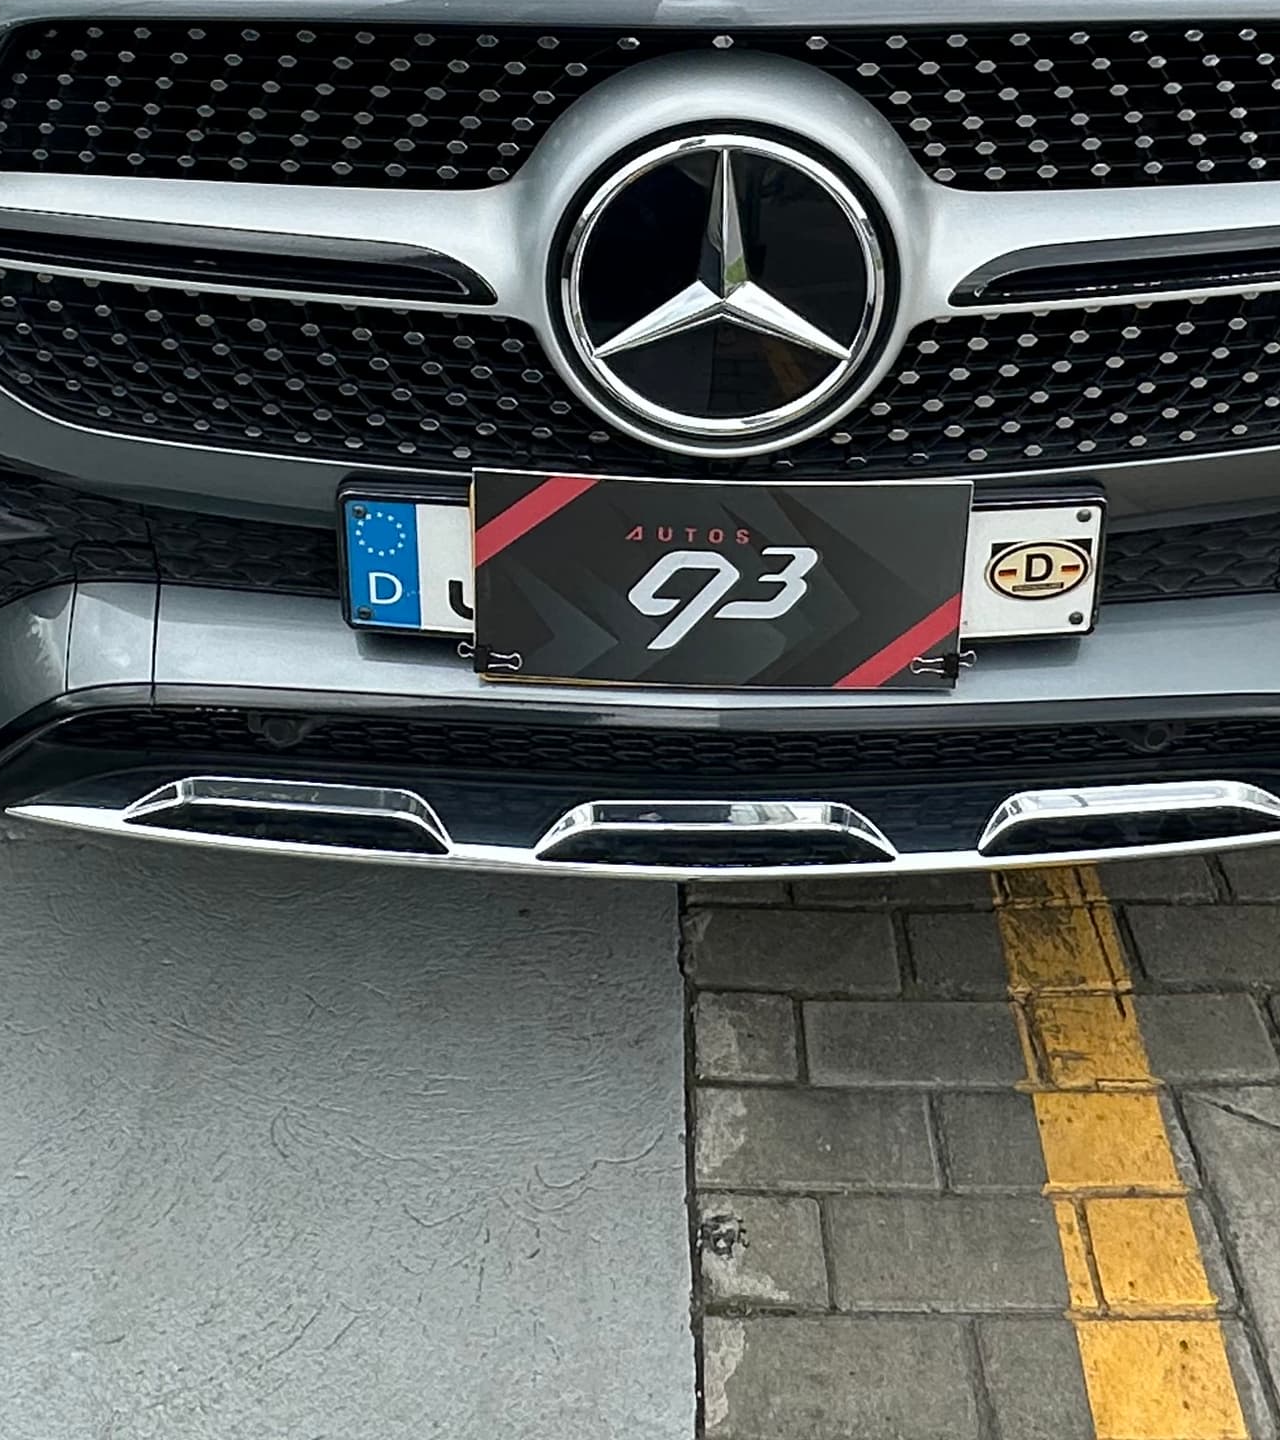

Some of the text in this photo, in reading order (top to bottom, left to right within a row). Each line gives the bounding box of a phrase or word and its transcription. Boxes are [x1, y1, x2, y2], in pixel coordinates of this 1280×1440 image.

[625, 525, 752, 545] AUTOS
[1024, 553, 1054, 583] D
[368, 571, 404, 606] D
[628, 546, 819, 651] 93
